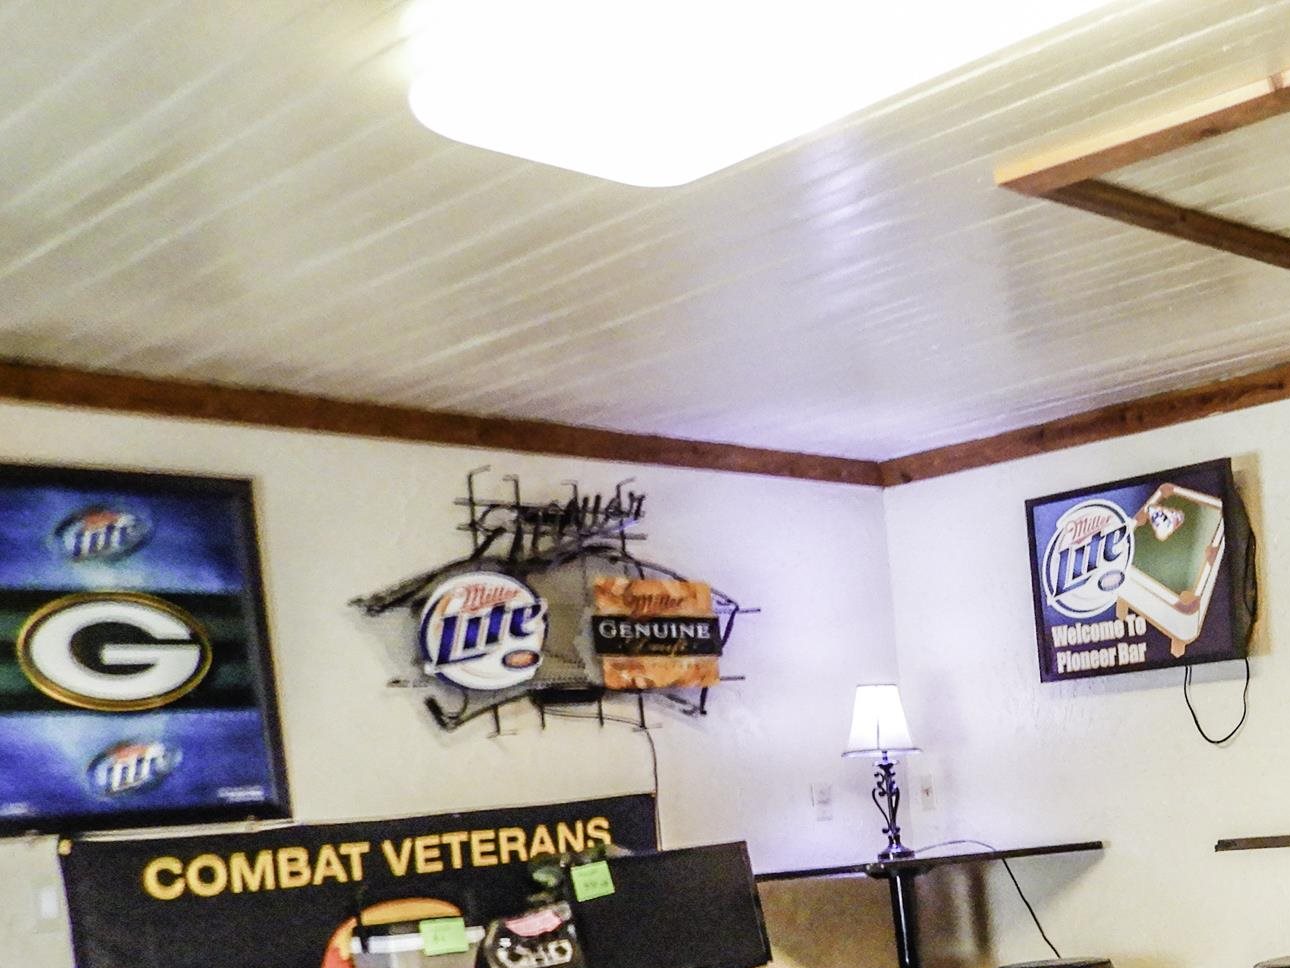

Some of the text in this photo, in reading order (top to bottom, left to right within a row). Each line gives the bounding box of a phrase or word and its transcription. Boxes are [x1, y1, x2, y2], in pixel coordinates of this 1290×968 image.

[1065, 515, 1112, 545] Miller
[1054, 525, 1127, 598] Lite
[459, 584, 521, 613] Miller
[435, 603, 542, 666] Lite
[598, 619, 711, 640] GENUINE
[1051, 619, 1125, 648] Welcome
[1056, 642, 1147, 674] Pioneer Bar
[142, 816, 612, 901] COMBAT VETERANS
